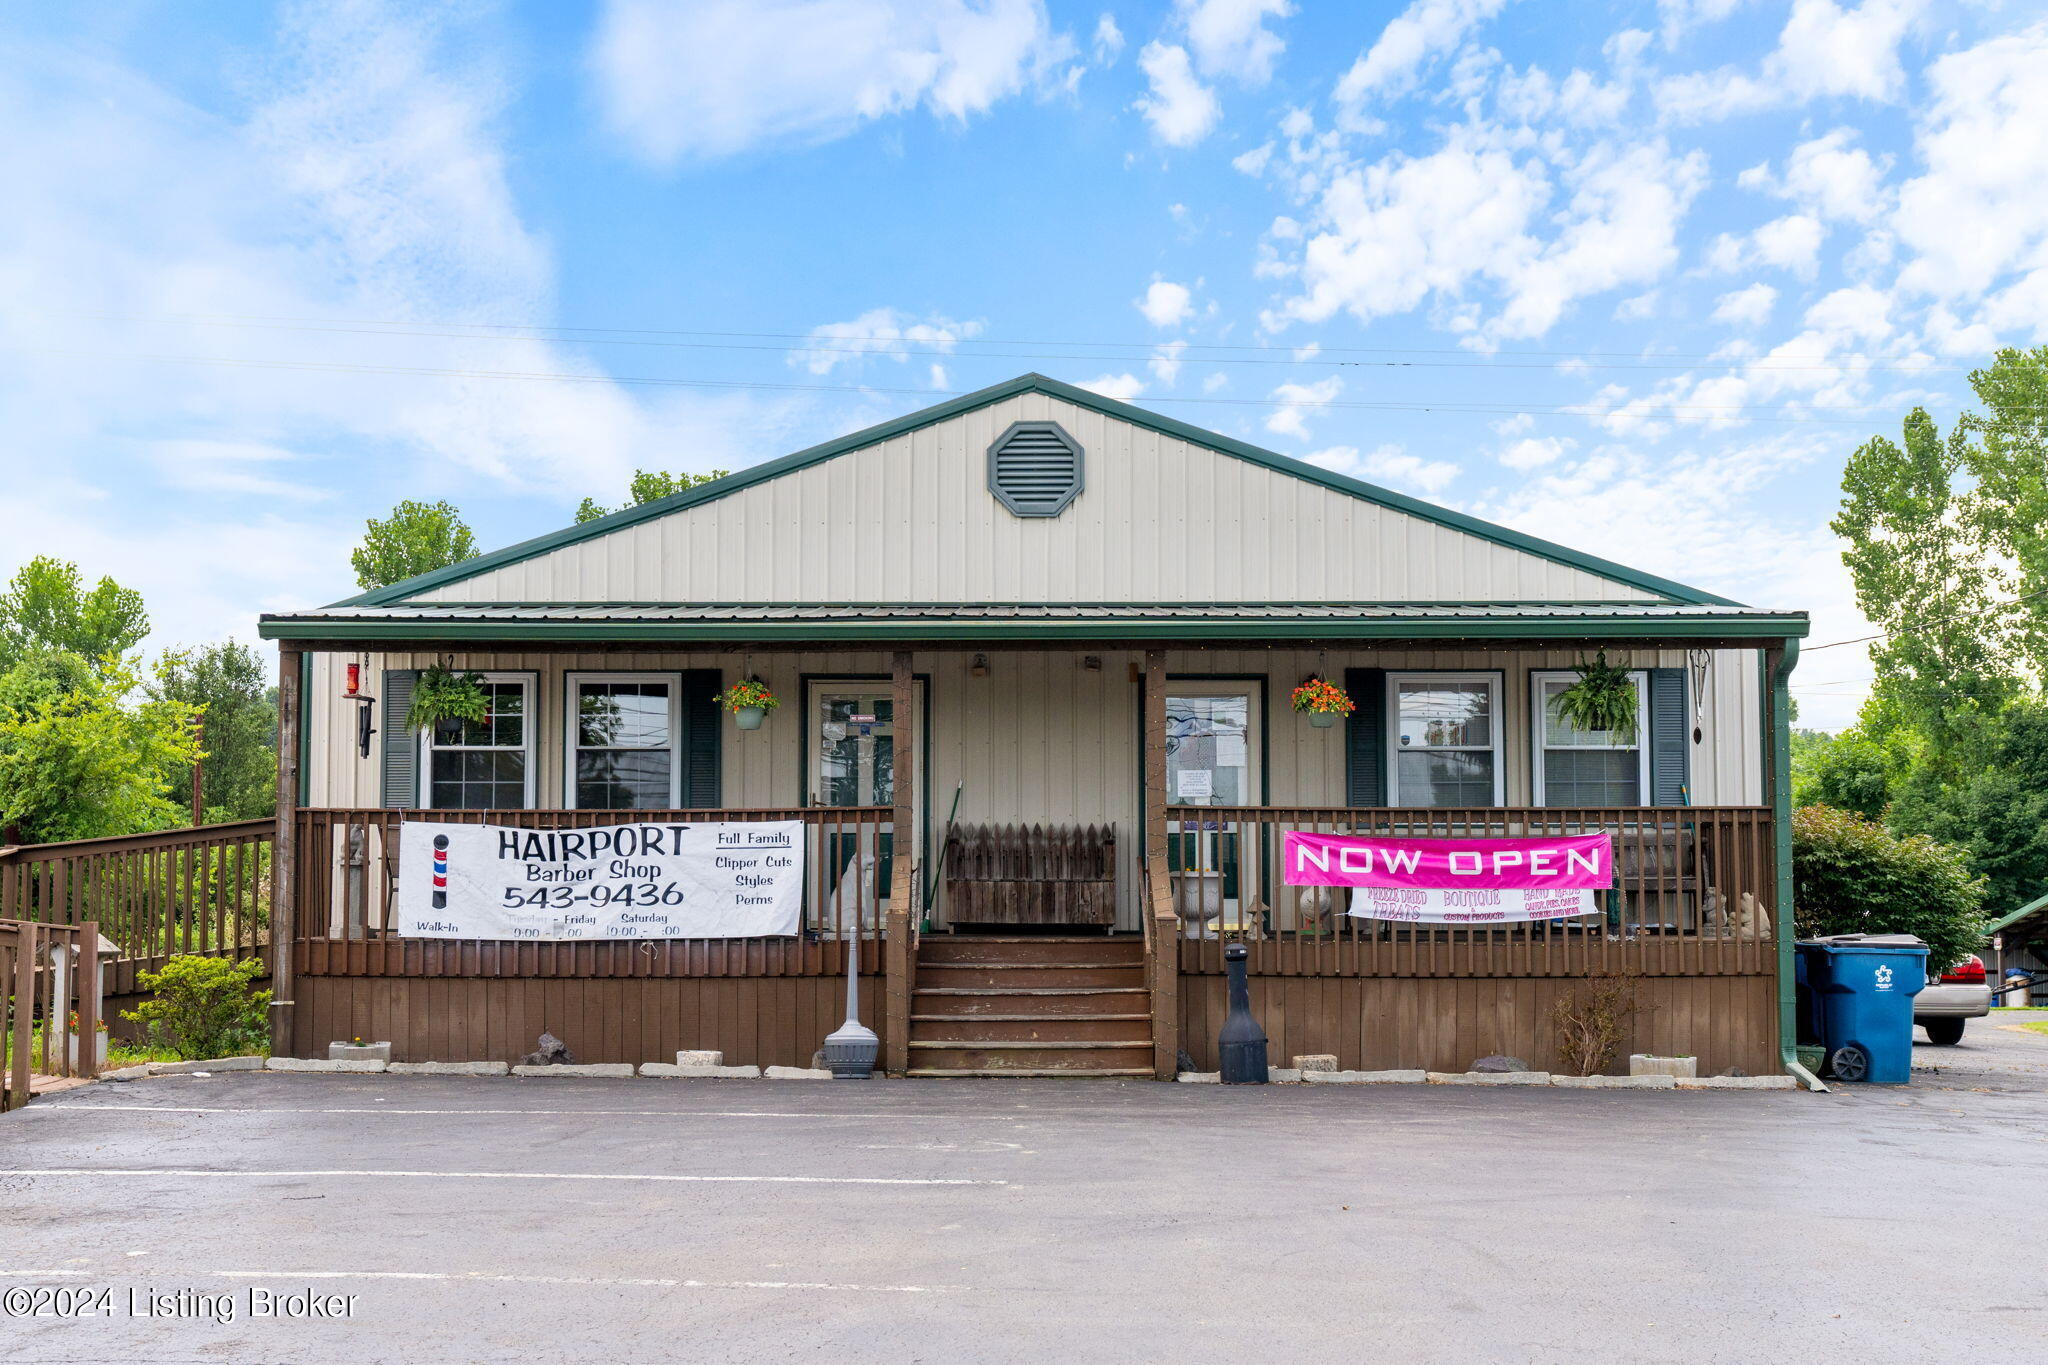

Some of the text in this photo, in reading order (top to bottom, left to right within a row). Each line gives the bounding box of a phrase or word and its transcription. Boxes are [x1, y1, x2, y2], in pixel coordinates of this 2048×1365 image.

[498, 826, 690, 862] HAIRPORT
[718, 832, 791, 846] Full Family
[715, 855, 792, 871] Clipper Cuts
[1297, 844, 1599, 876] NOW OPEN
[526, 859, 661, 882] Barber Shop
[735, 874, 773, 888] Styles
[502, 881, 684, 909] 543-9436
[736, 893, 773, 905] Perms
[1368, 887, 1427, 905] FREEZE DRIED
[1443, 889, 1501, 907] BOUTIQUE
[1523, 889, 1549, 901] HAND
[1373, 901, 1421, 920] TREATS
[1443, 912, 1505, 921] CUSTOM PRODUCTS
[1529, 910, 1552, 919] COOKIES
[1553, 909, 1564, 917] AND
[564, 915, 597, 927] Friday
[621, 913, 669, 924] Saturday
[417, 921, 459, 934] Walk-In
